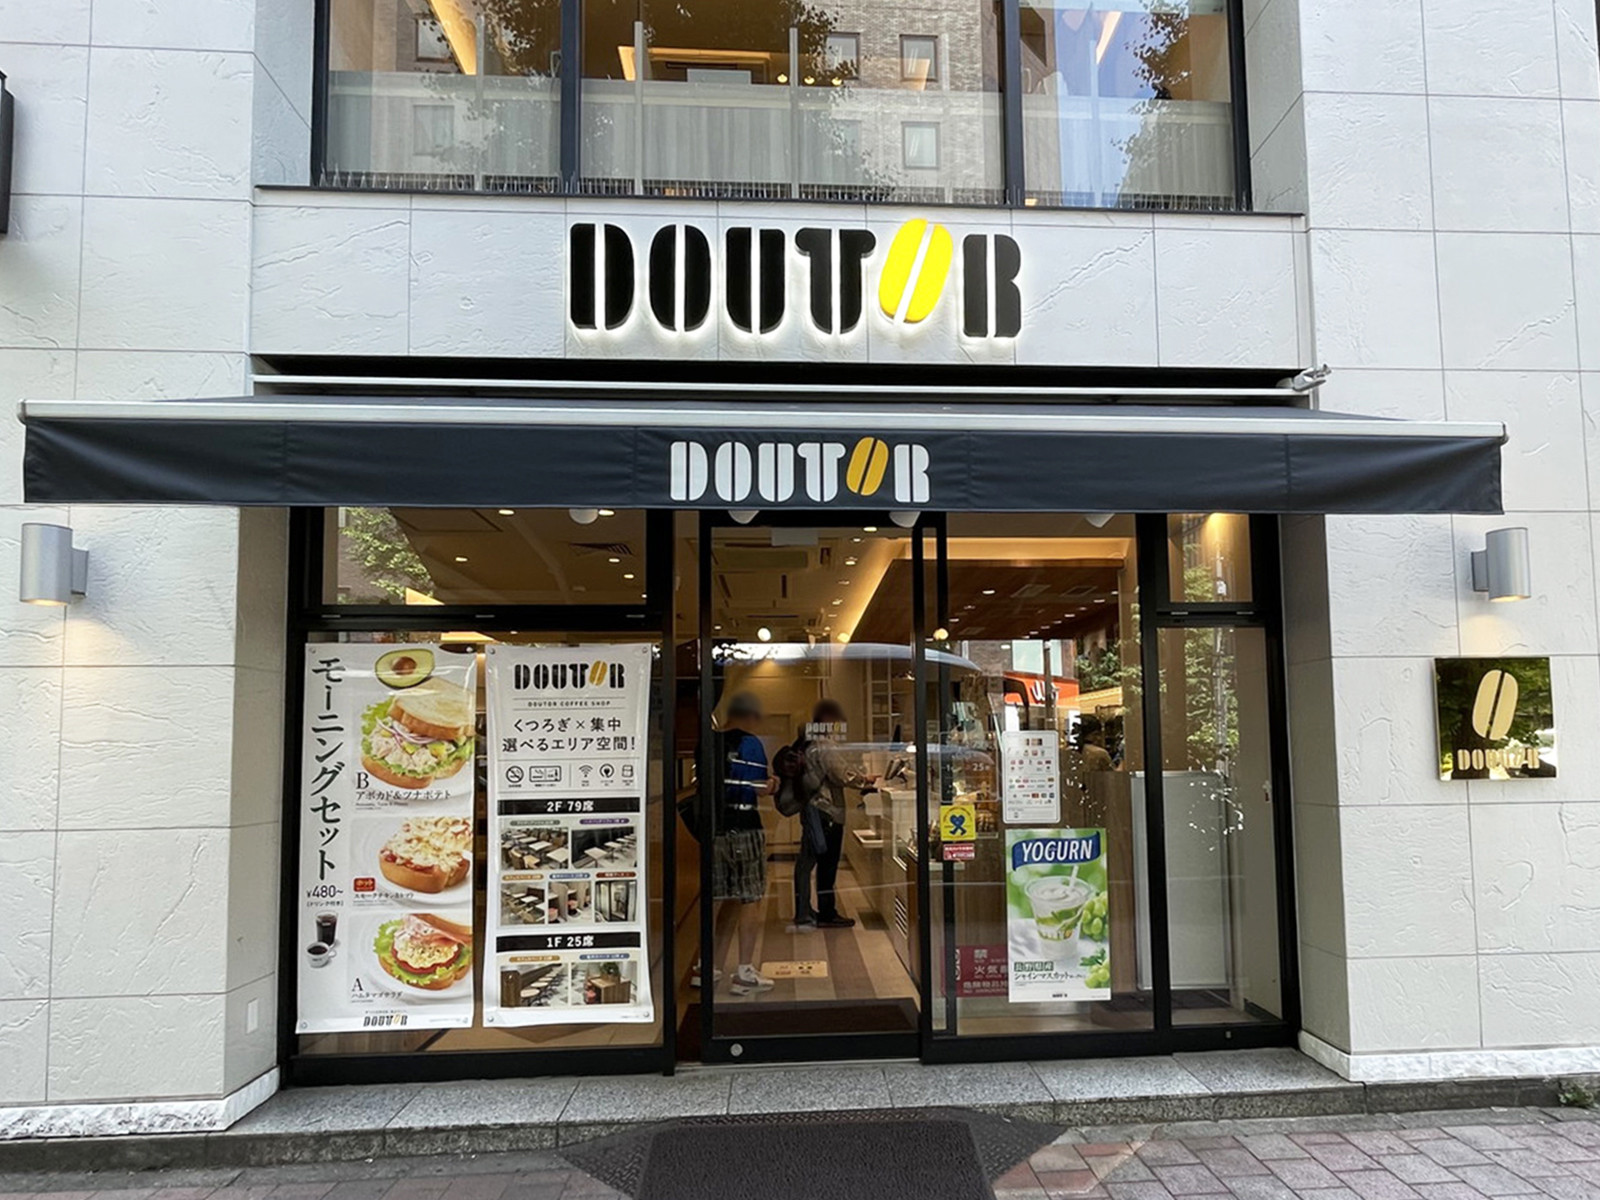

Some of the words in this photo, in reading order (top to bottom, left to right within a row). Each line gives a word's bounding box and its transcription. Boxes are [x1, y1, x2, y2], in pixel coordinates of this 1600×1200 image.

[571, 217, 1021, 338] DOUTOR
[670, 437, 930, 503] DOUTOR
[514, 660, 625, 690] DOUTOR
[502, 736, 636, 753] 選べるエリア空間!
[310, 657, 346, 881] モーニングセット
[355, 771, 369, 790] B
[547, 801, 563, 813] 2F
[567, 800, 594, 812] 79席
[1021, 839, 1093, 862] YOGURN
[547, 937, 562, 948] 1F
[567, 936, 594, 948] 25席
[351, 977, 363, 992] A
